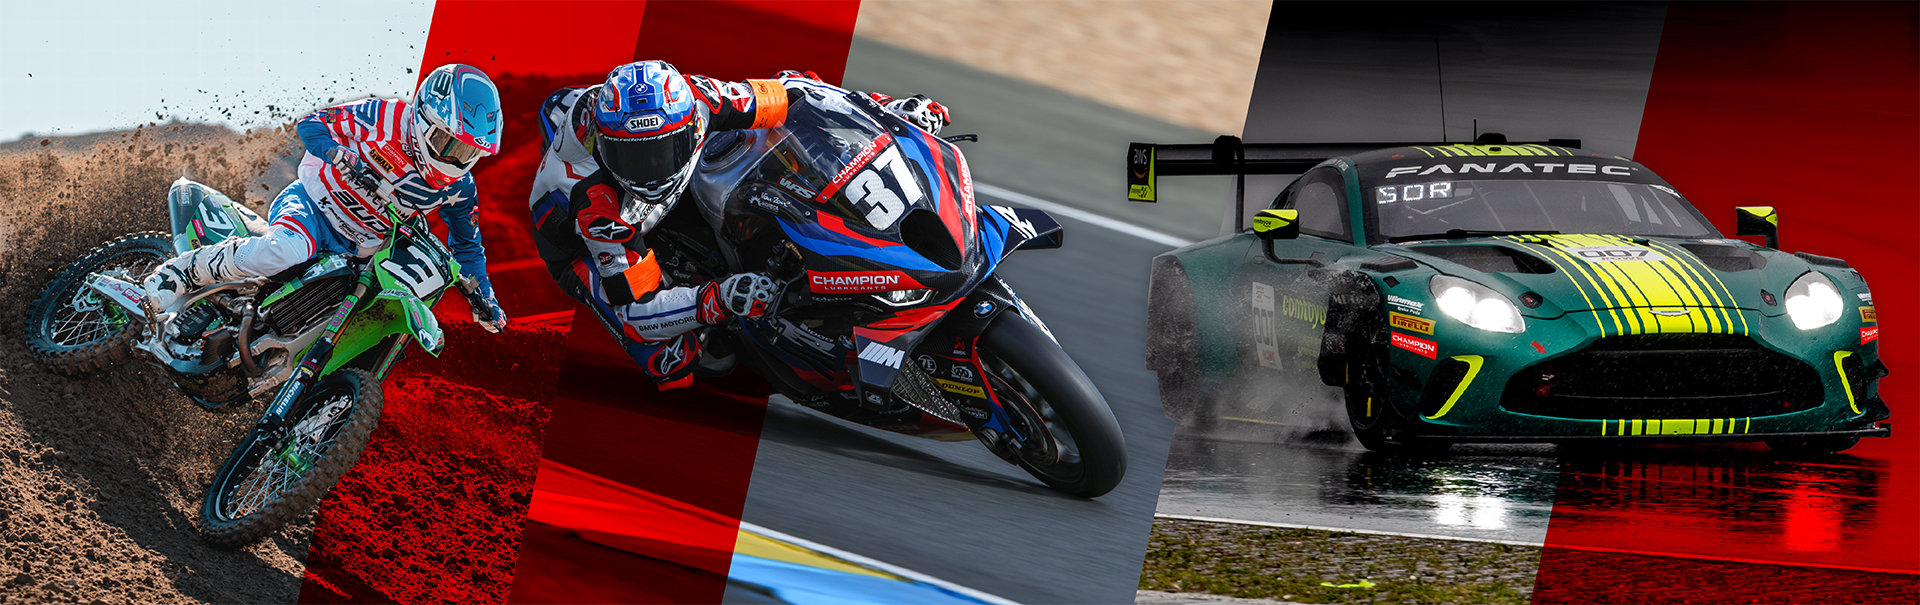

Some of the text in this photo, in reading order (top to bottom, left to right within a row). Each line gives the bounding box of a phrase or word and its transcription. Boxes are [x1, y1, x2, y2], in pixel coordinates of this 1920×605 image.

[630, 117, 659, 129] SHOEI
[832, 141, 877, 185] CHAMPION
[1133, 148, 1148, 165] aws
[842, 152, 876, 182] LUBRICANTS
[1385, 163, 1632, 179] FANATEC
[779, 177, 817, 199] WRS
[845, 144, 924, 231] 37
[1379, 182, 1451, 204] SOR
[198, 202, 237, 230] 3
[331, 190, 391, 233] BUD
[1577, 250, 1650, 258] 007
[379, 245, 445, 299] 3
[813, 275, 899, 285] CHAMPION
[638, 323, 659, 332] BMW
[1392, 315, 1430, 332] PIRELLI
[1392, 334, 1435, 352] CHAMPION
[276, 381, 301, 415] MICHELIN
[941, 383, 980, 395] DUNLOP
